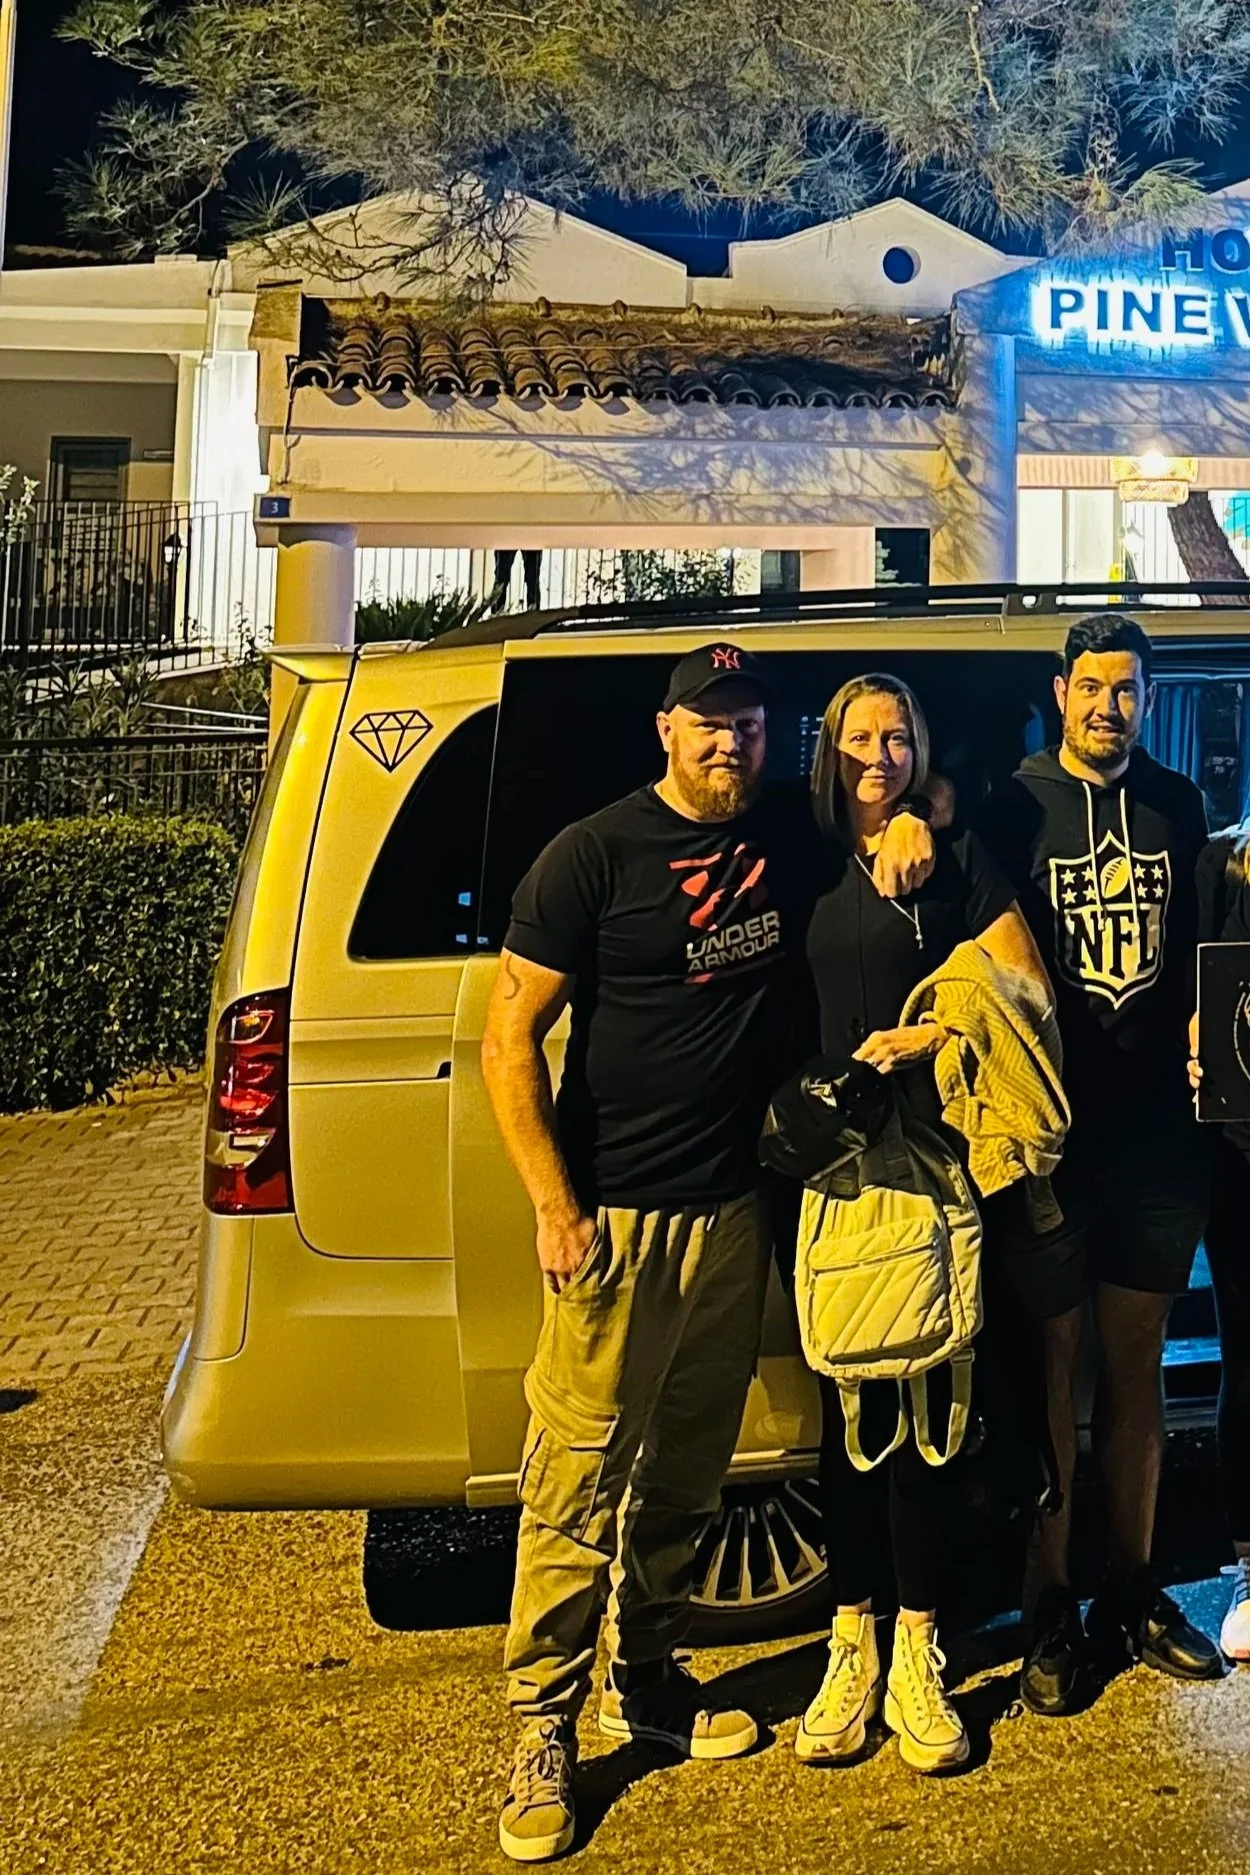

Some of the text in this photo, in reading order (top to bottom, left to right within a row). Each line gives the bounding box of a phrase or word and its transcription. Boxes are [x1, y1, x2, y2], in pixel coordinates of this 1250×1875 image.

[1047, 287, 1210, 332] PINE
[270, 501, 279, 514] 3
[686, 910, 780, 960] UNDER
[687, 931, 779, 972] ARMOUR
[1066, 906, 1160, 981] NFL
